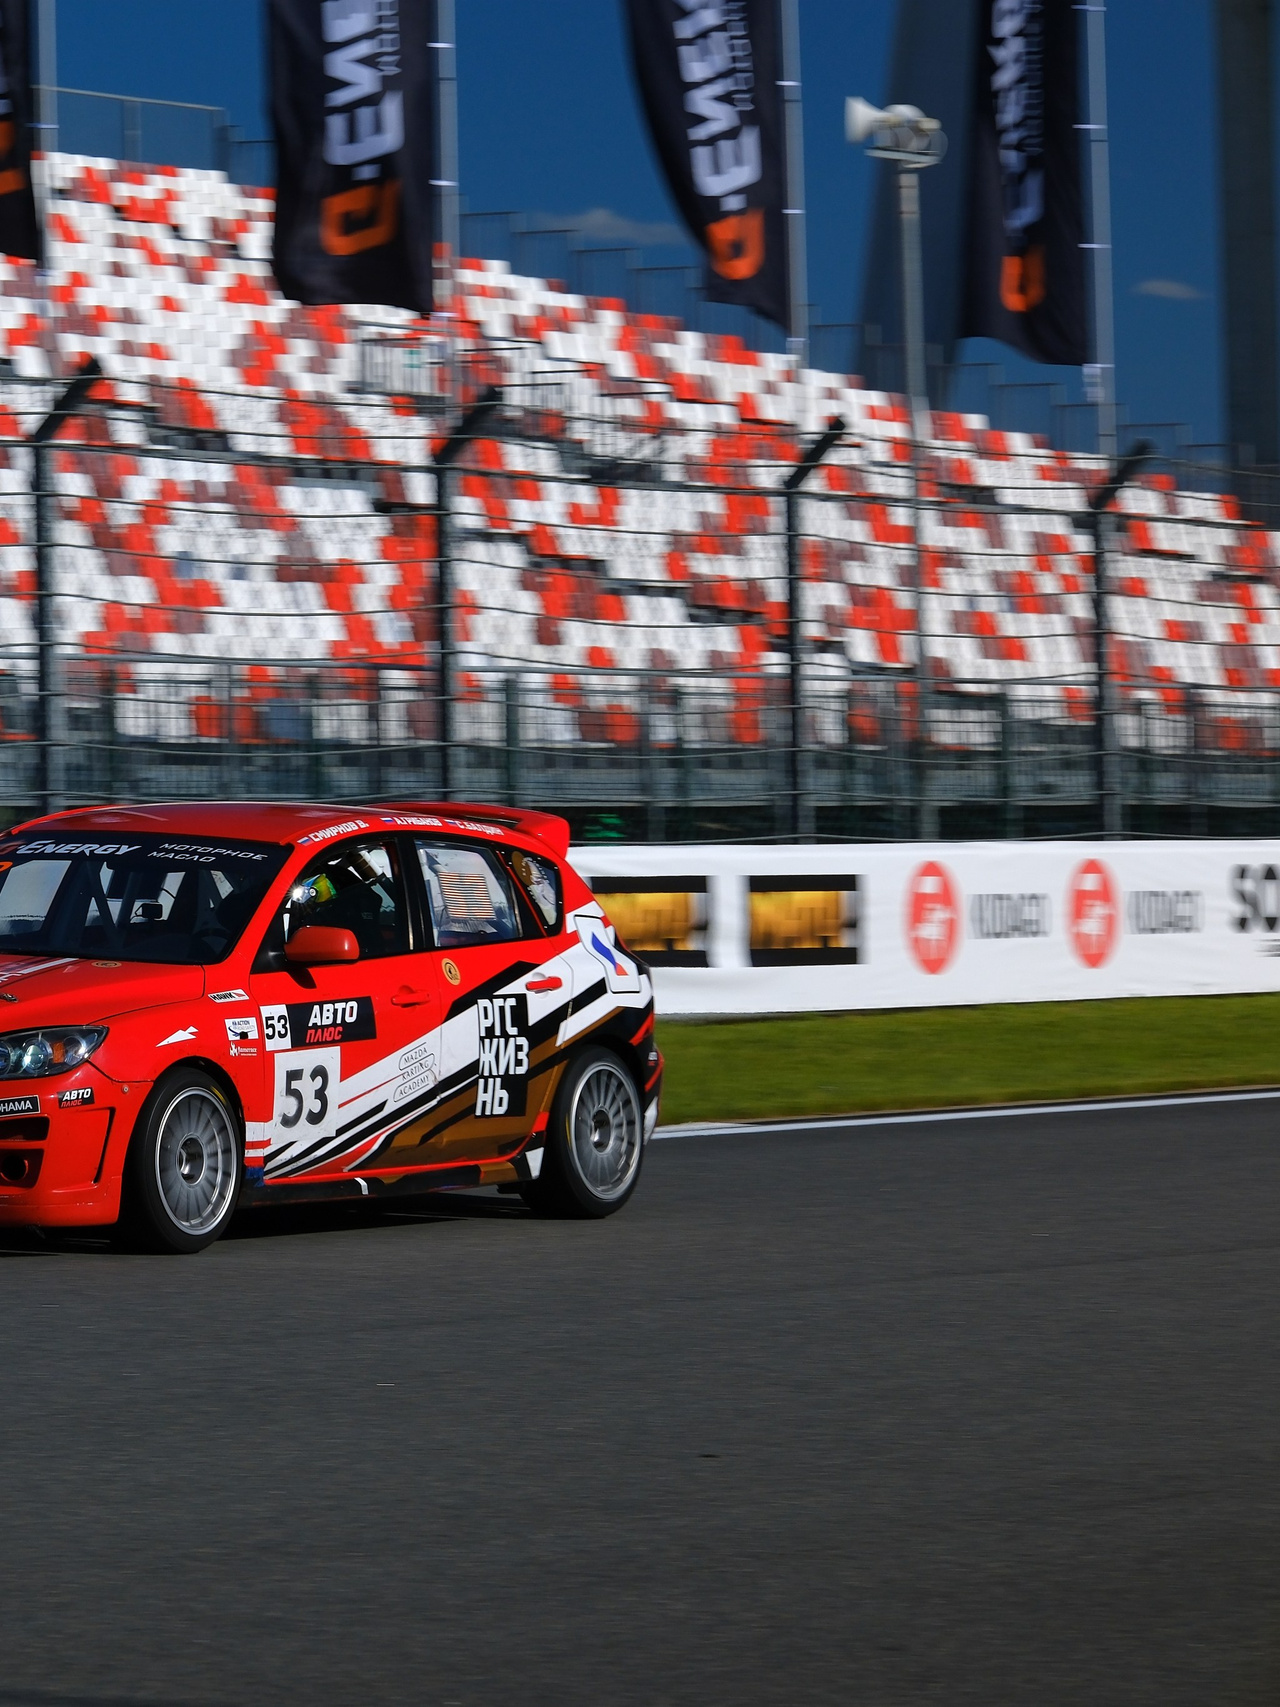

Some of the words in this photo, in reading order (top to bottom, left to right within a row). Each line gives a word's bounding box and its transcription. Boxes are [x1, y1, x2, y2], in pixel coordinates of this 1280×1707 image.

[147, 851, 216, 862] МАСЛО
[159, 843, 268, 861] МОТОРНОЕ
[308, 1001, 358, 1026] АВТО
[477, 998, 518, 1036] РГС
[265, 1015, 288, 1039] 53
[306, 1027, 343, 1043] ПЛЮС
[403, 1047, 428, 1065] MAZDA
[479, 1037, 529, 1076] ЖИЗ
[62, 1088, 91, 1101] АВТО
[280, 1065, 329, 1128] 53
[400, 1074, 429, 1097] ACADEMY
[475, 1078, 509, 1116] НЬ
[61, 1099, 83, 1108] ПЛЮС
